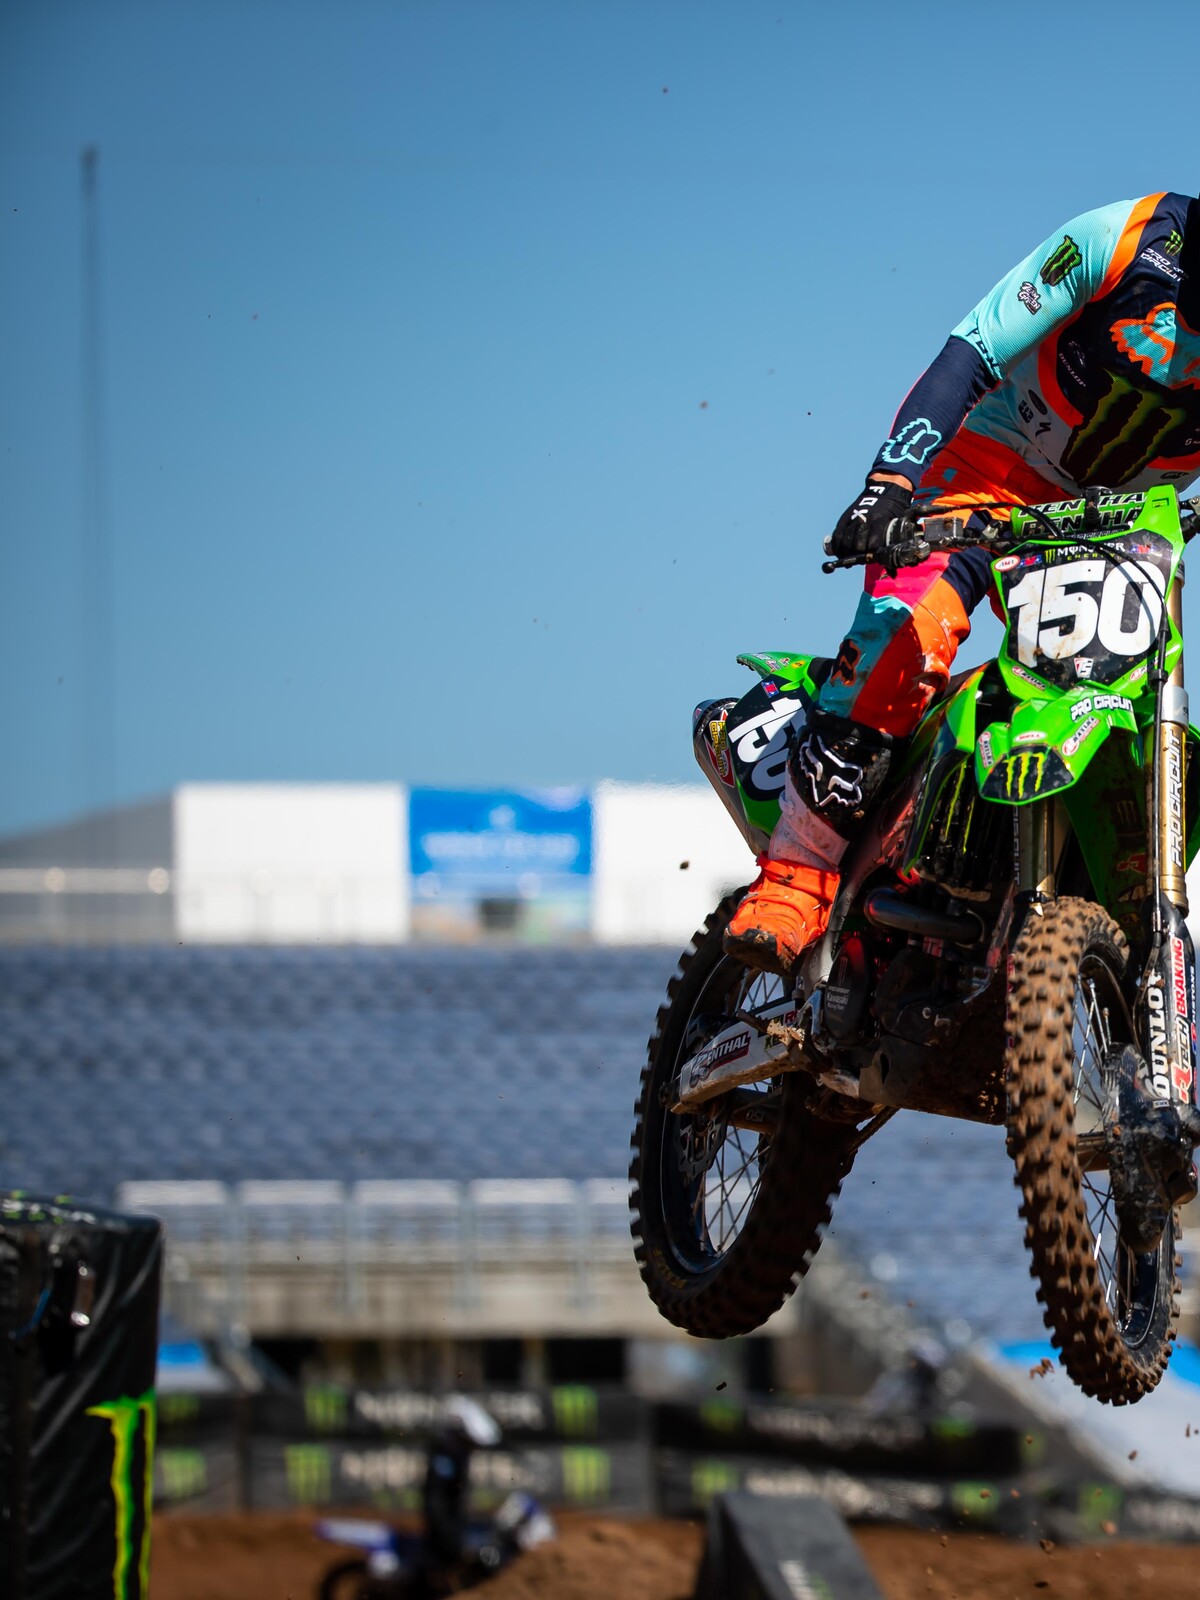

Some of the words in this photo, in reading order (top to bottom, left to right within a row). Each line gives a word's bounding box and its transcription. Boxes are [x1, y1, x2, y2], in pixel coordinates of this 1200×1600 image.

[1058, 352, 1087, 388] DUNLOP
[850, 485, 886, 523] FOX
[1007, 559, 1166, 668] 150
[1070, 698, 1092, 721] PRO
[1169, 729, 1182, 818] CIRCUIT
[1170, 817, 1182, 867] PRO
[1172, 937, 1187, 1016] BRAKING
